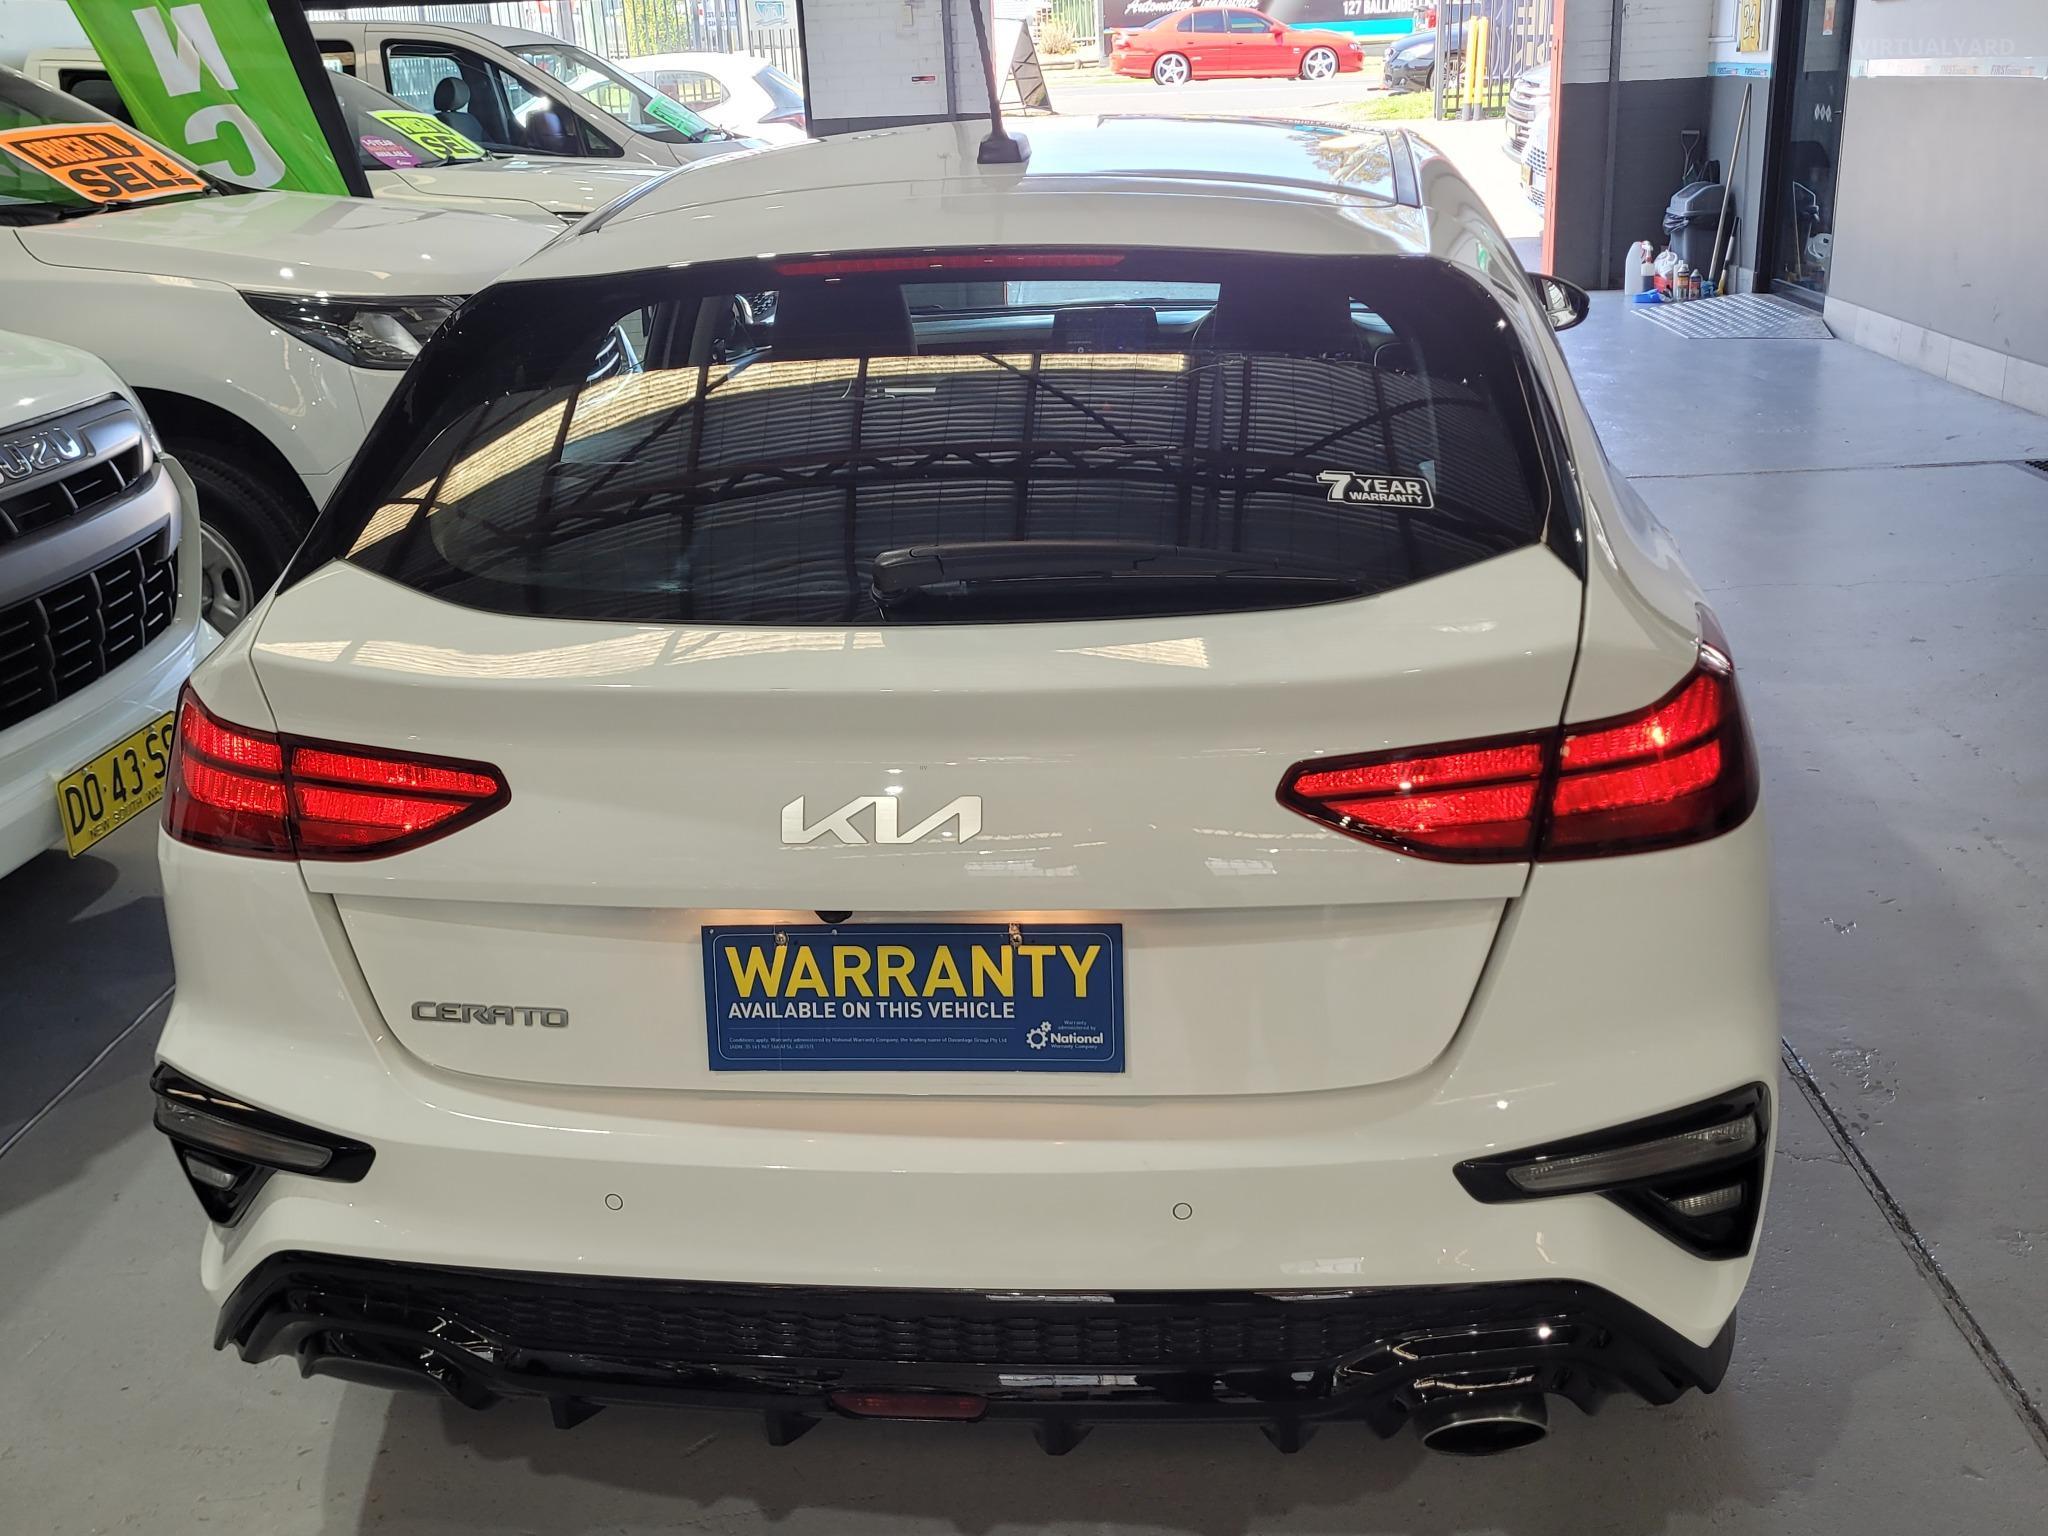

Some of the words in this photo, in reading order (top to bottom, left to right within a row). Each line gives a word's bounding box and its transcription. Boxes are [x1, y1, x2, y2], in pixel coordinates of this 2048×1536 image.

[1343, 0, 1361, 16] 127
[68, 160, 202, 198] SELL
[1319, 473, 1351, 499] 7
[1356, 478, 1422, 495] YEAR
[1349, 491, 1423, 503] WARRANTY
[781, 795, 982, 844] KIA
[724, 945, 1101, 998] WARRANTY
[411, 1001, 569, 1028] CERATO
[728, 1002, 836, 1019] AVAILABLE
[842, 1002, 871, 1019] ON
[876, 1002, 923, 1019] THIS
[928, 1002, 1015, 1019] VEHICLE
[1050, 1032, 1104, 1044] National
